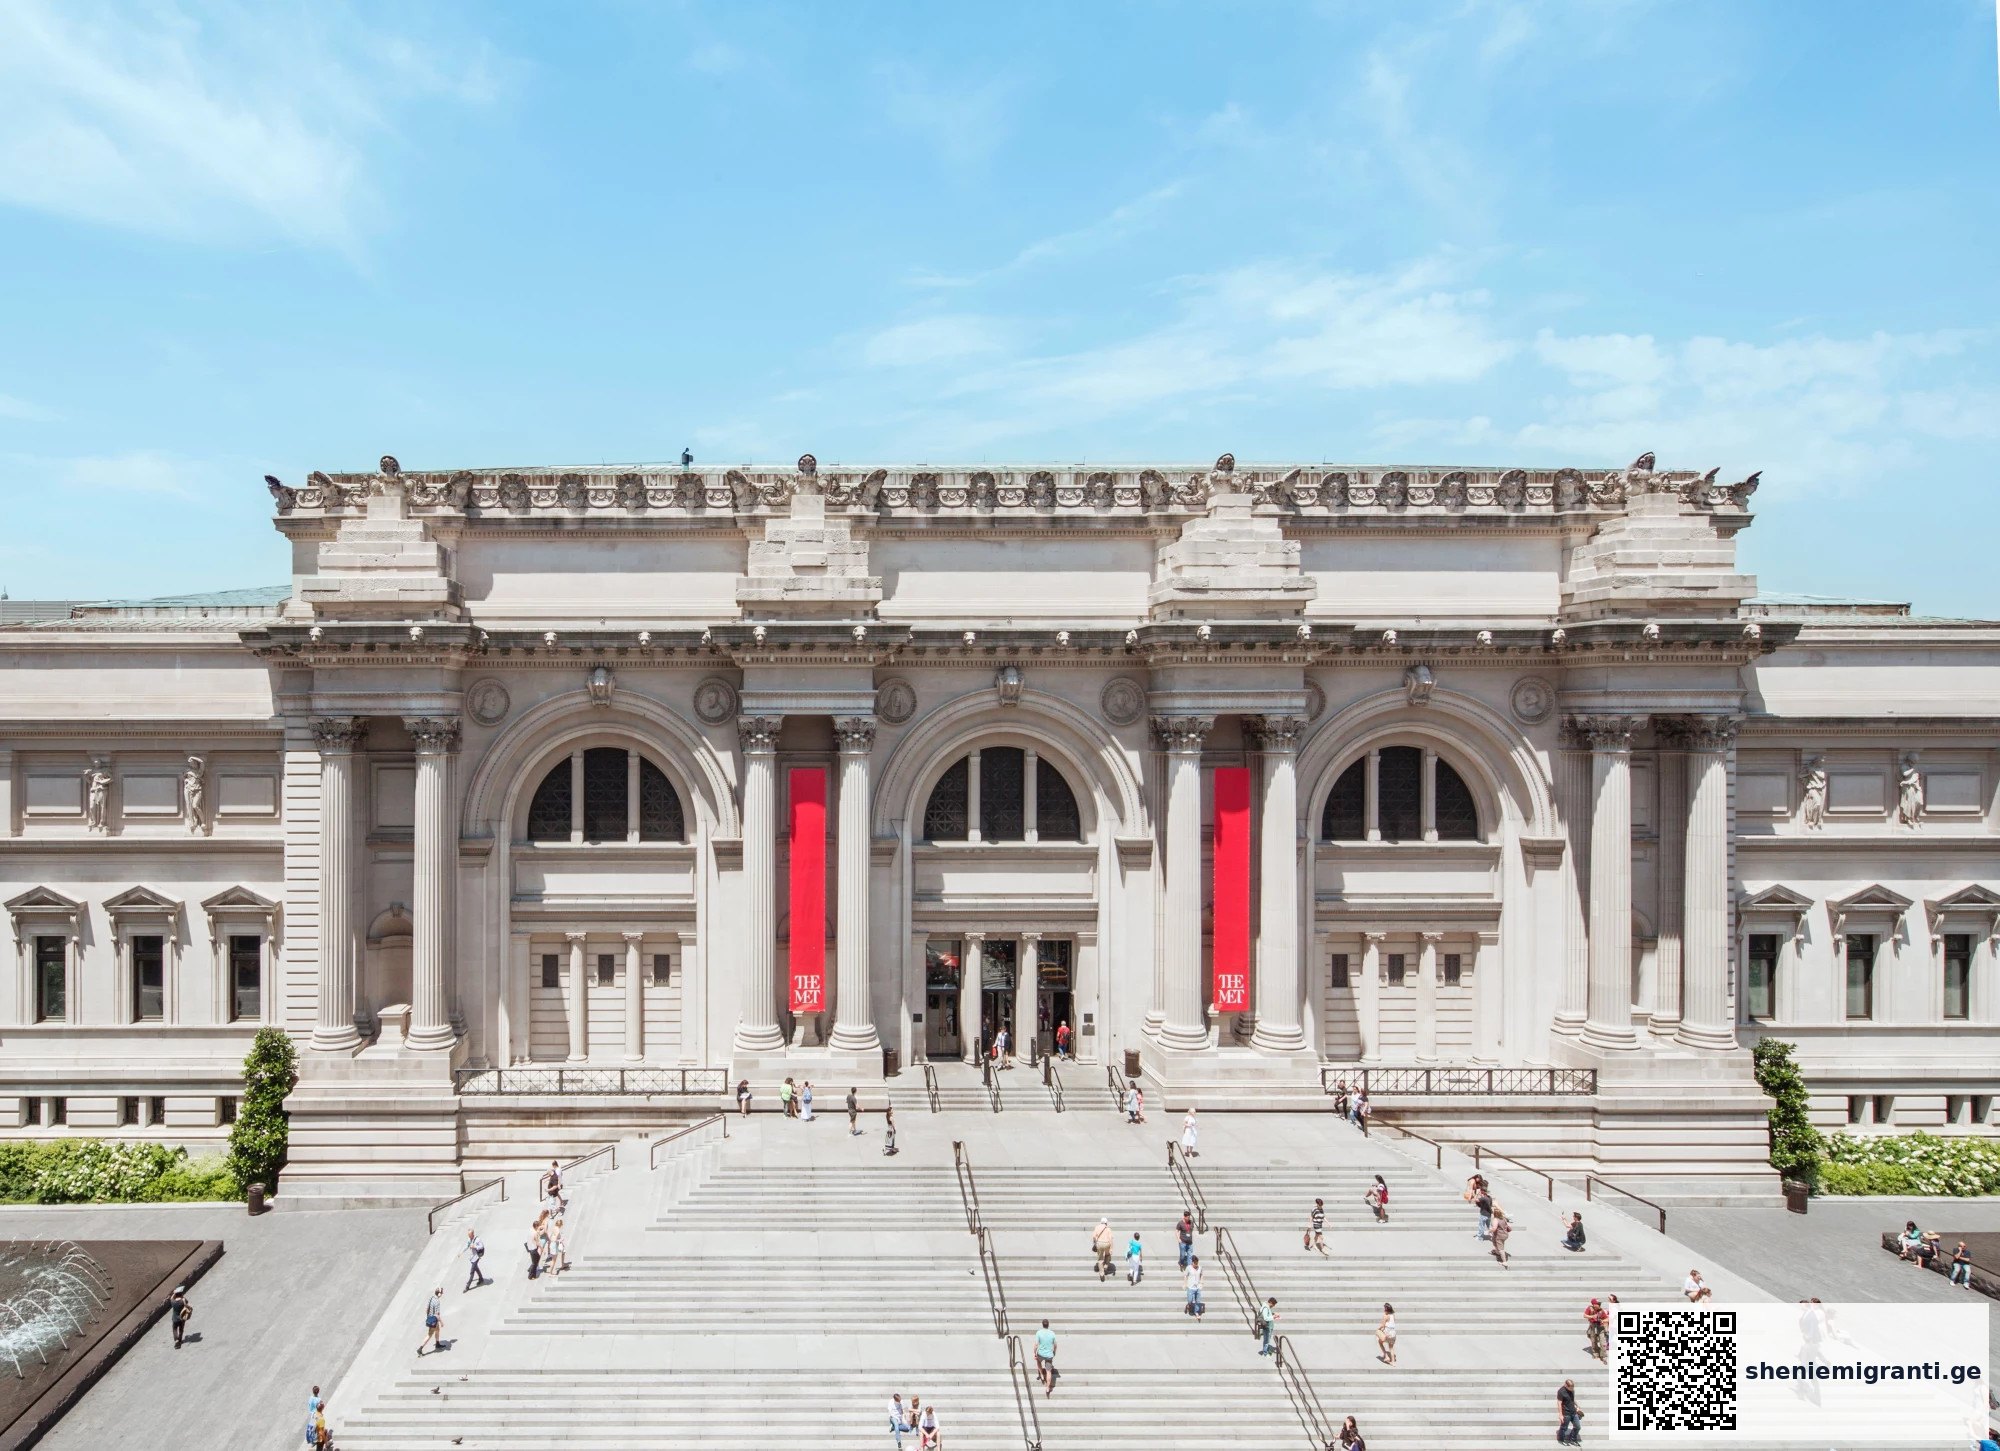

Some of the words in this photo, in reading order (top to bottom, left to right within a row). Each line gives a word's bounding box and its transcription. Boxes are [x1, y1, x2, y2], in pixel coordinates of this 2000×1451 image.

[794, 975, 821, 989] THE
[1218, 974, 1244, 989] THE
[794, 989, 821, 1004] MET
[1218, 989, 1245, 1004] MET
